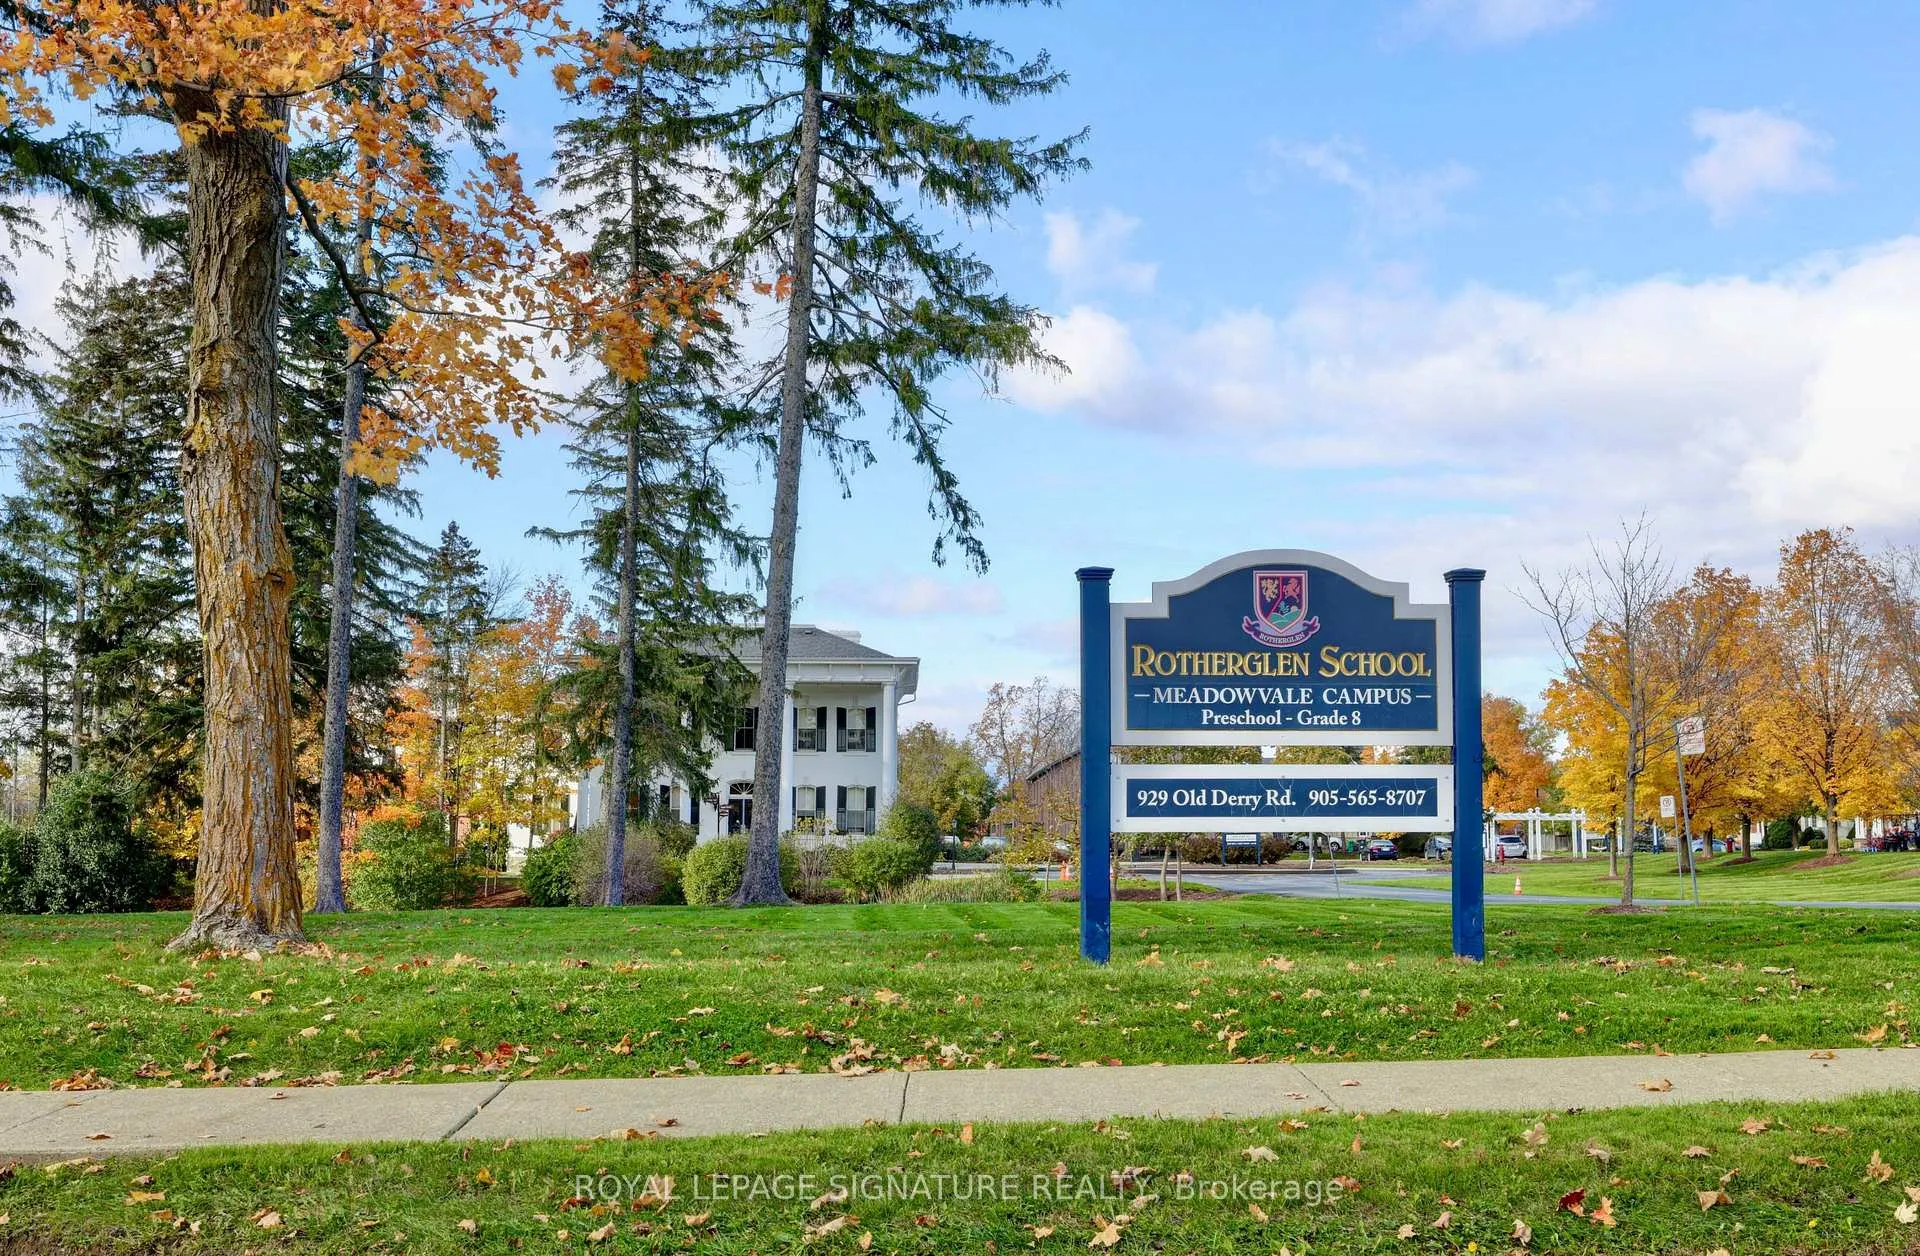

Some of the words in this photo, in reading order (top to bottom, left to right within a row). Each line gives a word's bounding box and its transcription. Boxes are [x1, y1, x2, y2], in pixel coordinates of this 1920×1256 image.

[1131, 644, 1310, 678] ROTHERGLEN
[1318, 644, 1432, 678] SCHOOL
[1153, 687, 1314, 705] MEADOWVALE
[1322, 687, 1412, 705] CAMPUS
[1201, 709, 1281, 726] Preschool
[1297, 709, 1348, 726] Grade
[1352, 710, 1361, 726] 8
[1137, 790, 1169, 807] 929
[1172, 788, 1207, 807] Old
[1211, 789, 1262, 811] Derry
[1265, 788, 1296, 807] Rd.
[1309, 789, 1426, 807] 905-565-8707
